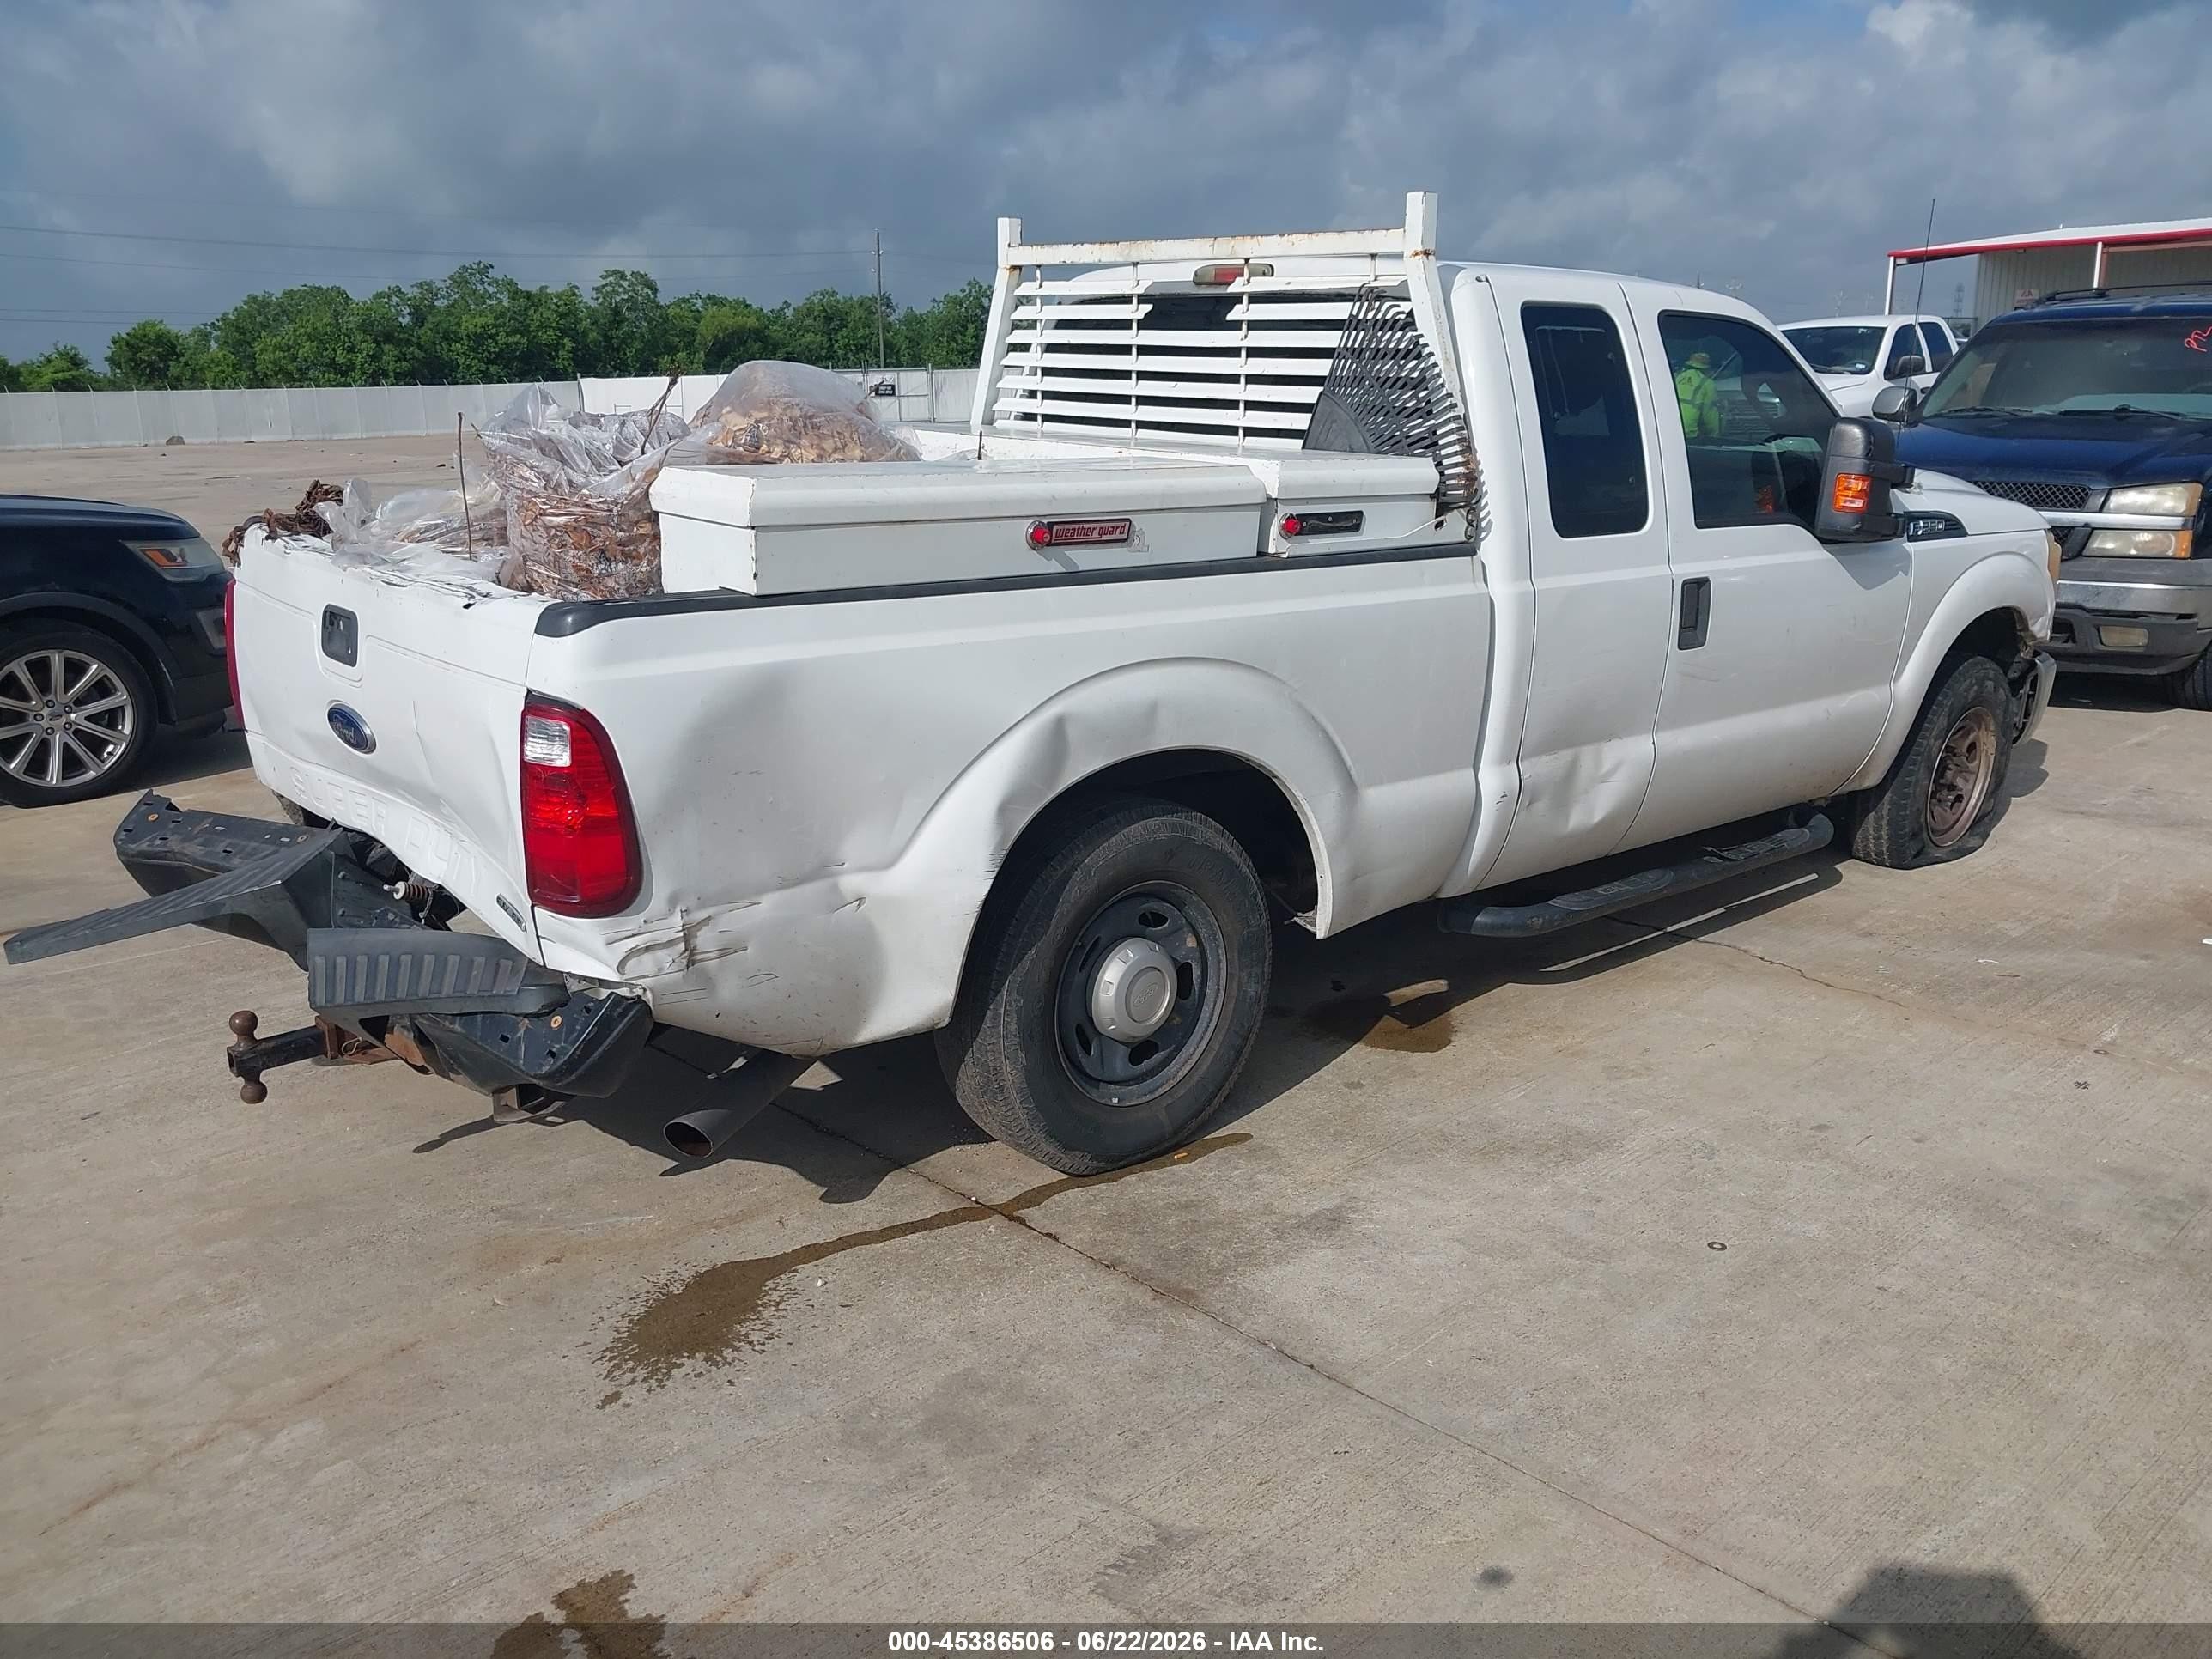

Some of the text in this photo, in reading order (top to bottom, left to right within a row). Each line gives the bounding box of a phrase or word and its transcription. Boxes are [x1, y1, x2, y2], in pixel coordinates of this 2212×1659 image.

[1054, 523, 1127, 538] weather guard
[289, 765, 388, 839] SUPER
